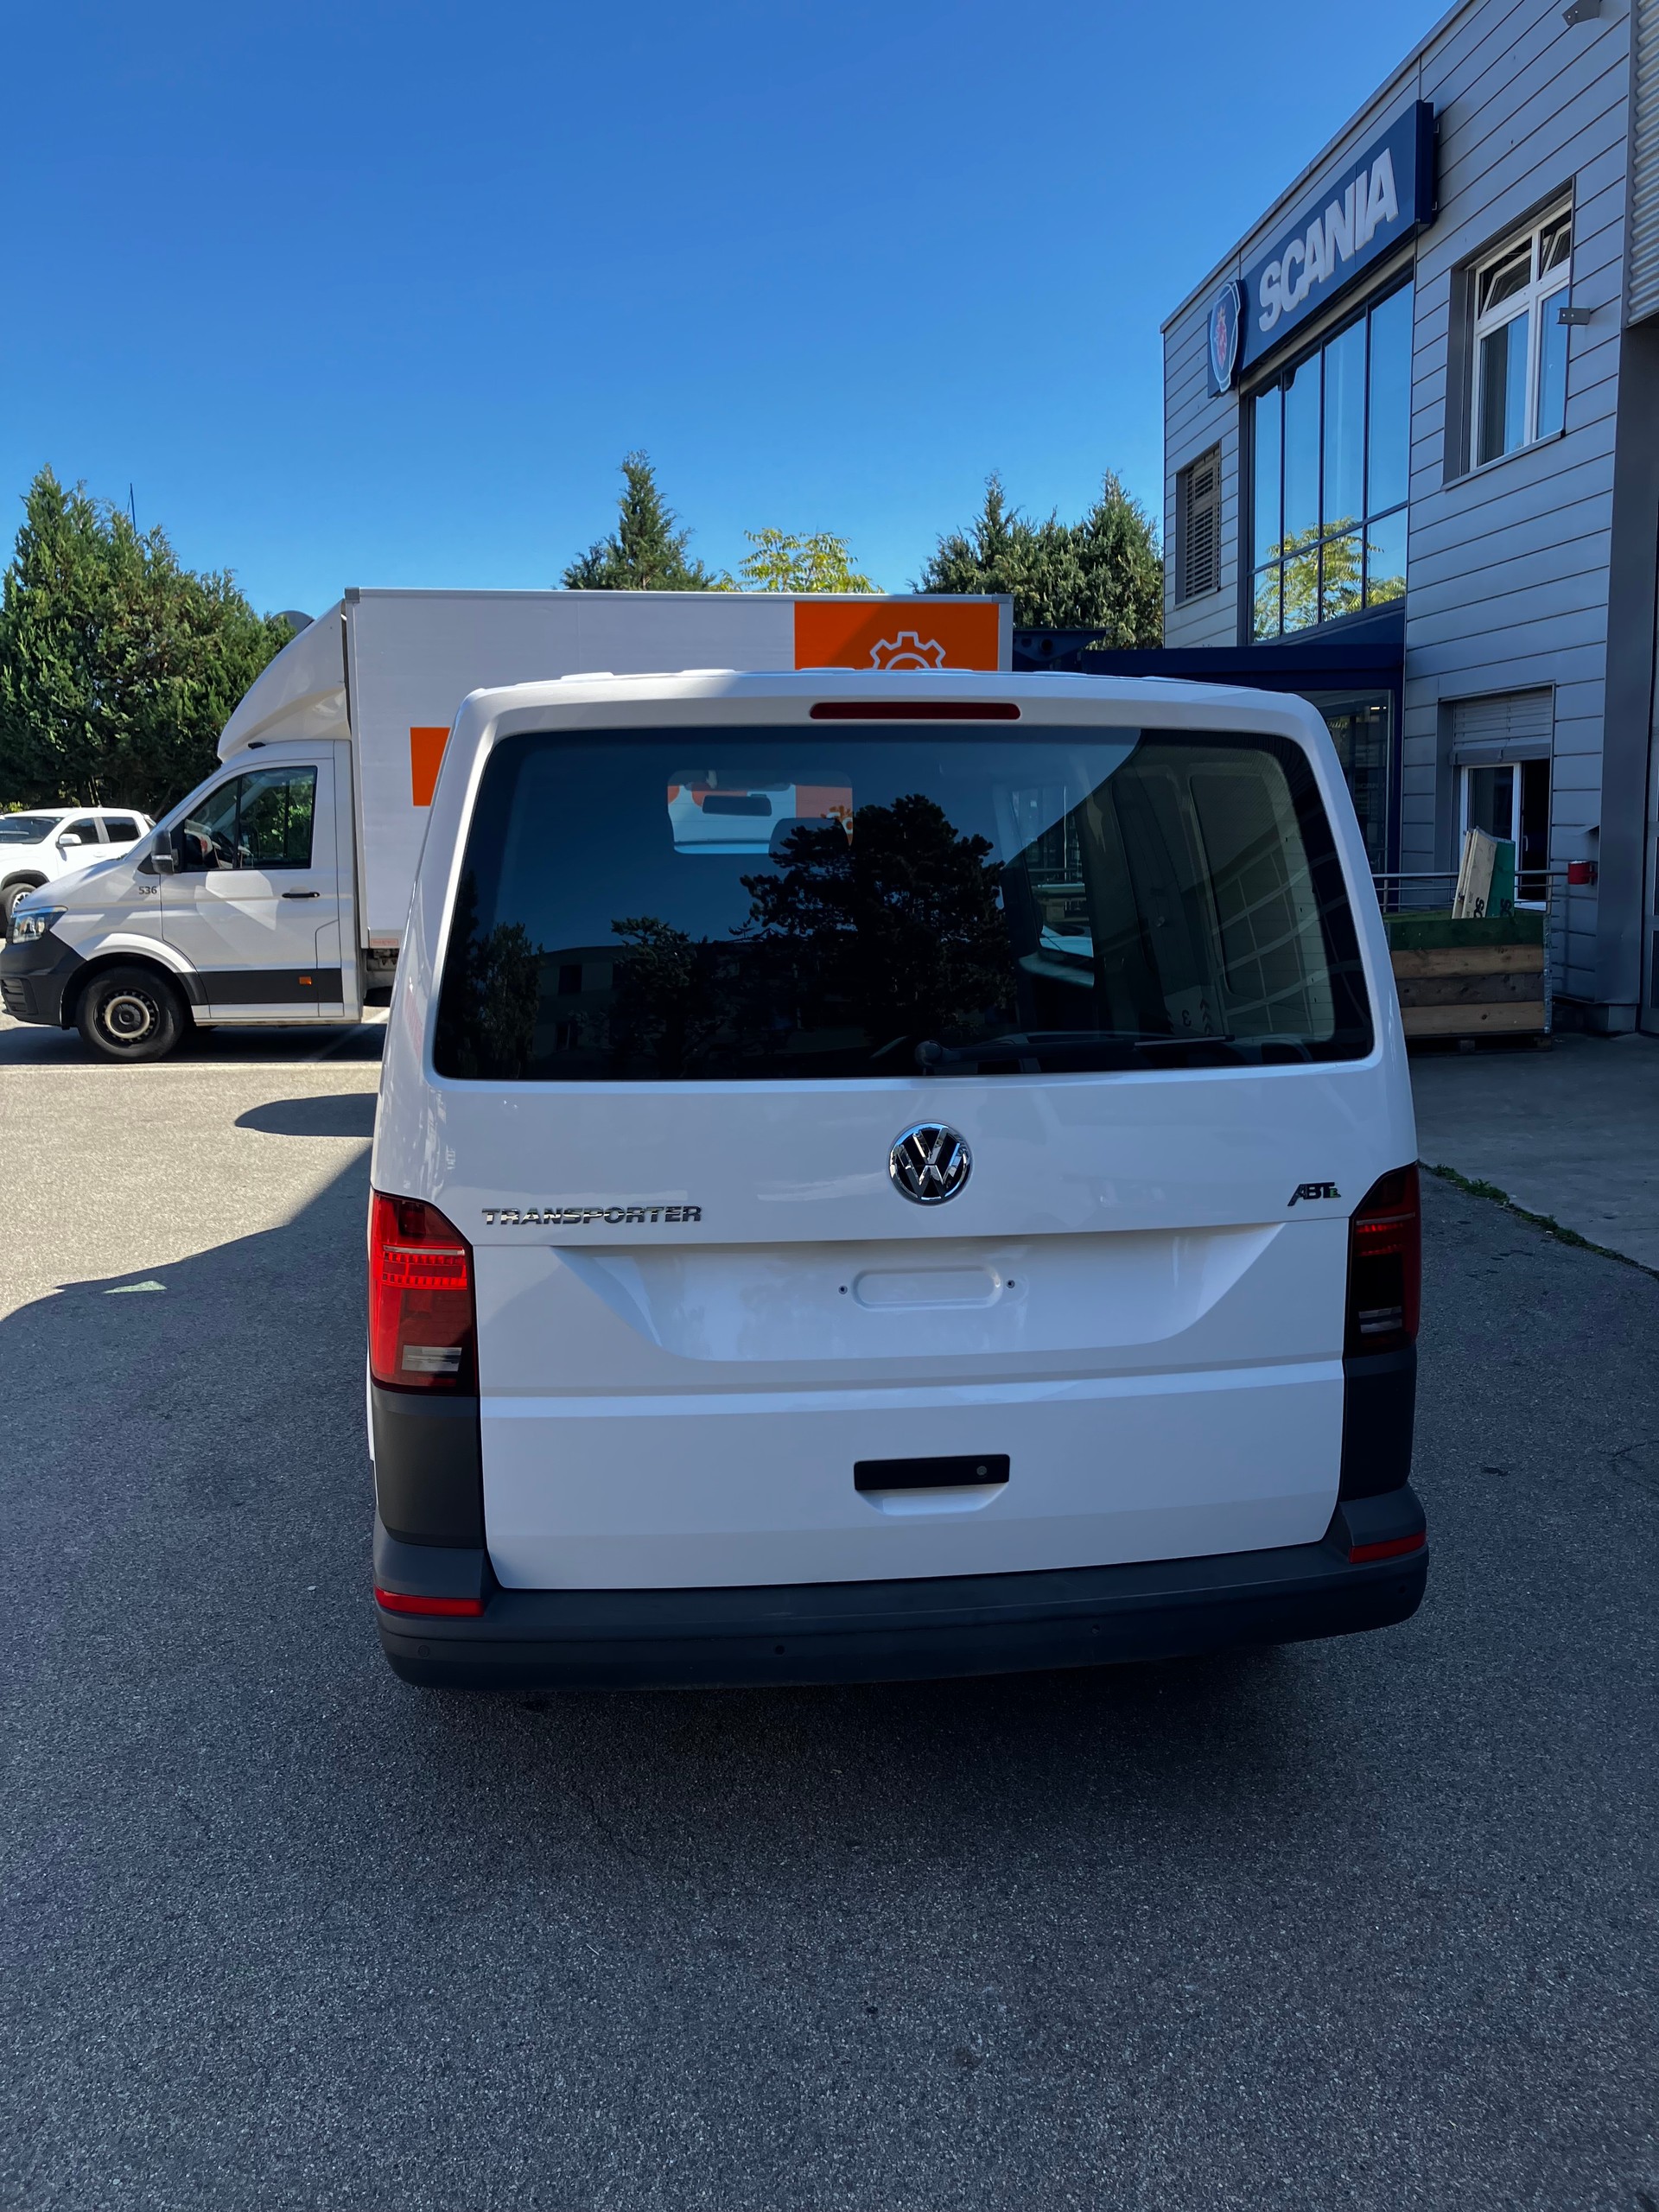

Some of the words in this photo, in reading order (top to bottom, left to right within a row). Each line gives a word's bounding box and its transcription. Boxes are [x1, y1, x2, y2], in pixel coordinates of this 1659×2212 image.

[1258, 147, 1399, 332] SCANIA
[138, 886, 157, 895] 536
[893, 1126, 964, 1199] VW
[481, 1205, 702, 1225] TRANSPORTER
